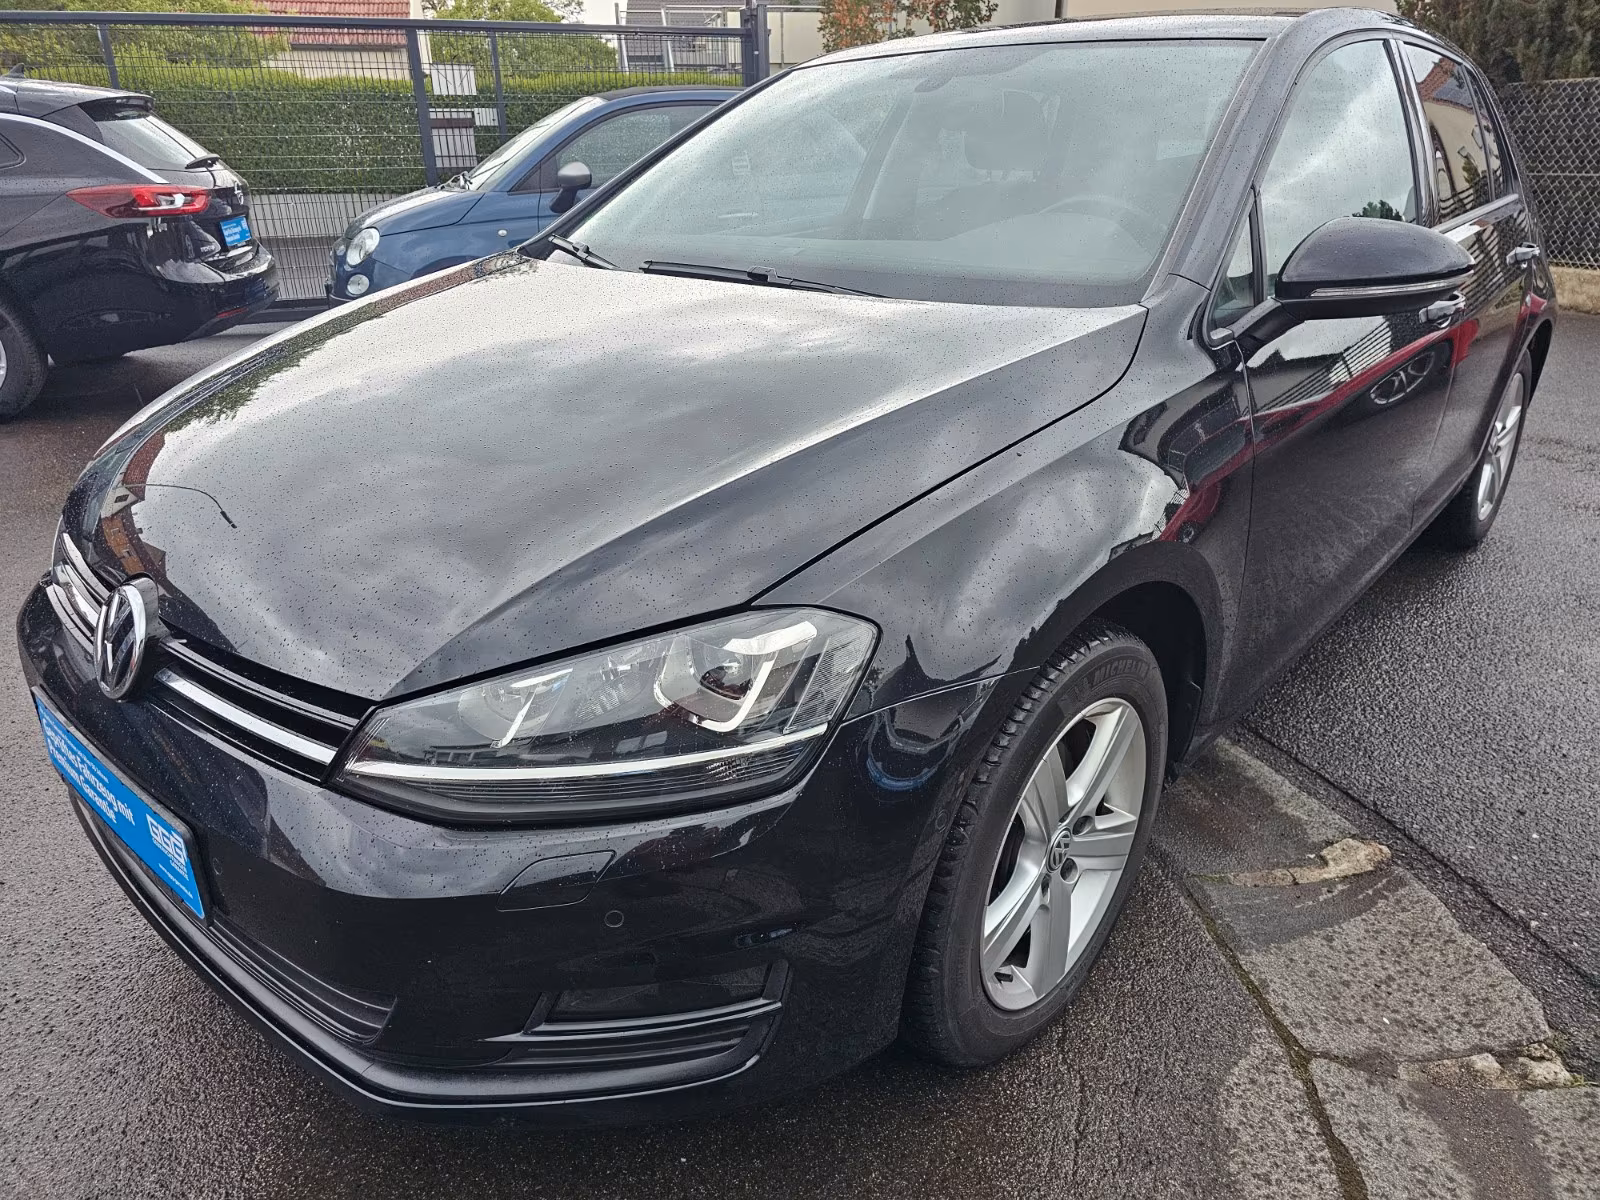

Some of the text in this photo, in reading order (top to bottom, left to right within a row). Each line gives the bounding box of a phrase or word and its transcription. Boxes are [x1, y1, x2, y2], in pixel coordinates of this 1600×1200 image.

[1093, 659, 1149, 685] MICHELIN
[77, 755, 118, 812] Fahrzeug
[118, 802, 136, 826] mit
[79, 774, 117, 824] Garantie
[146, 813, 188, 865] GGG
